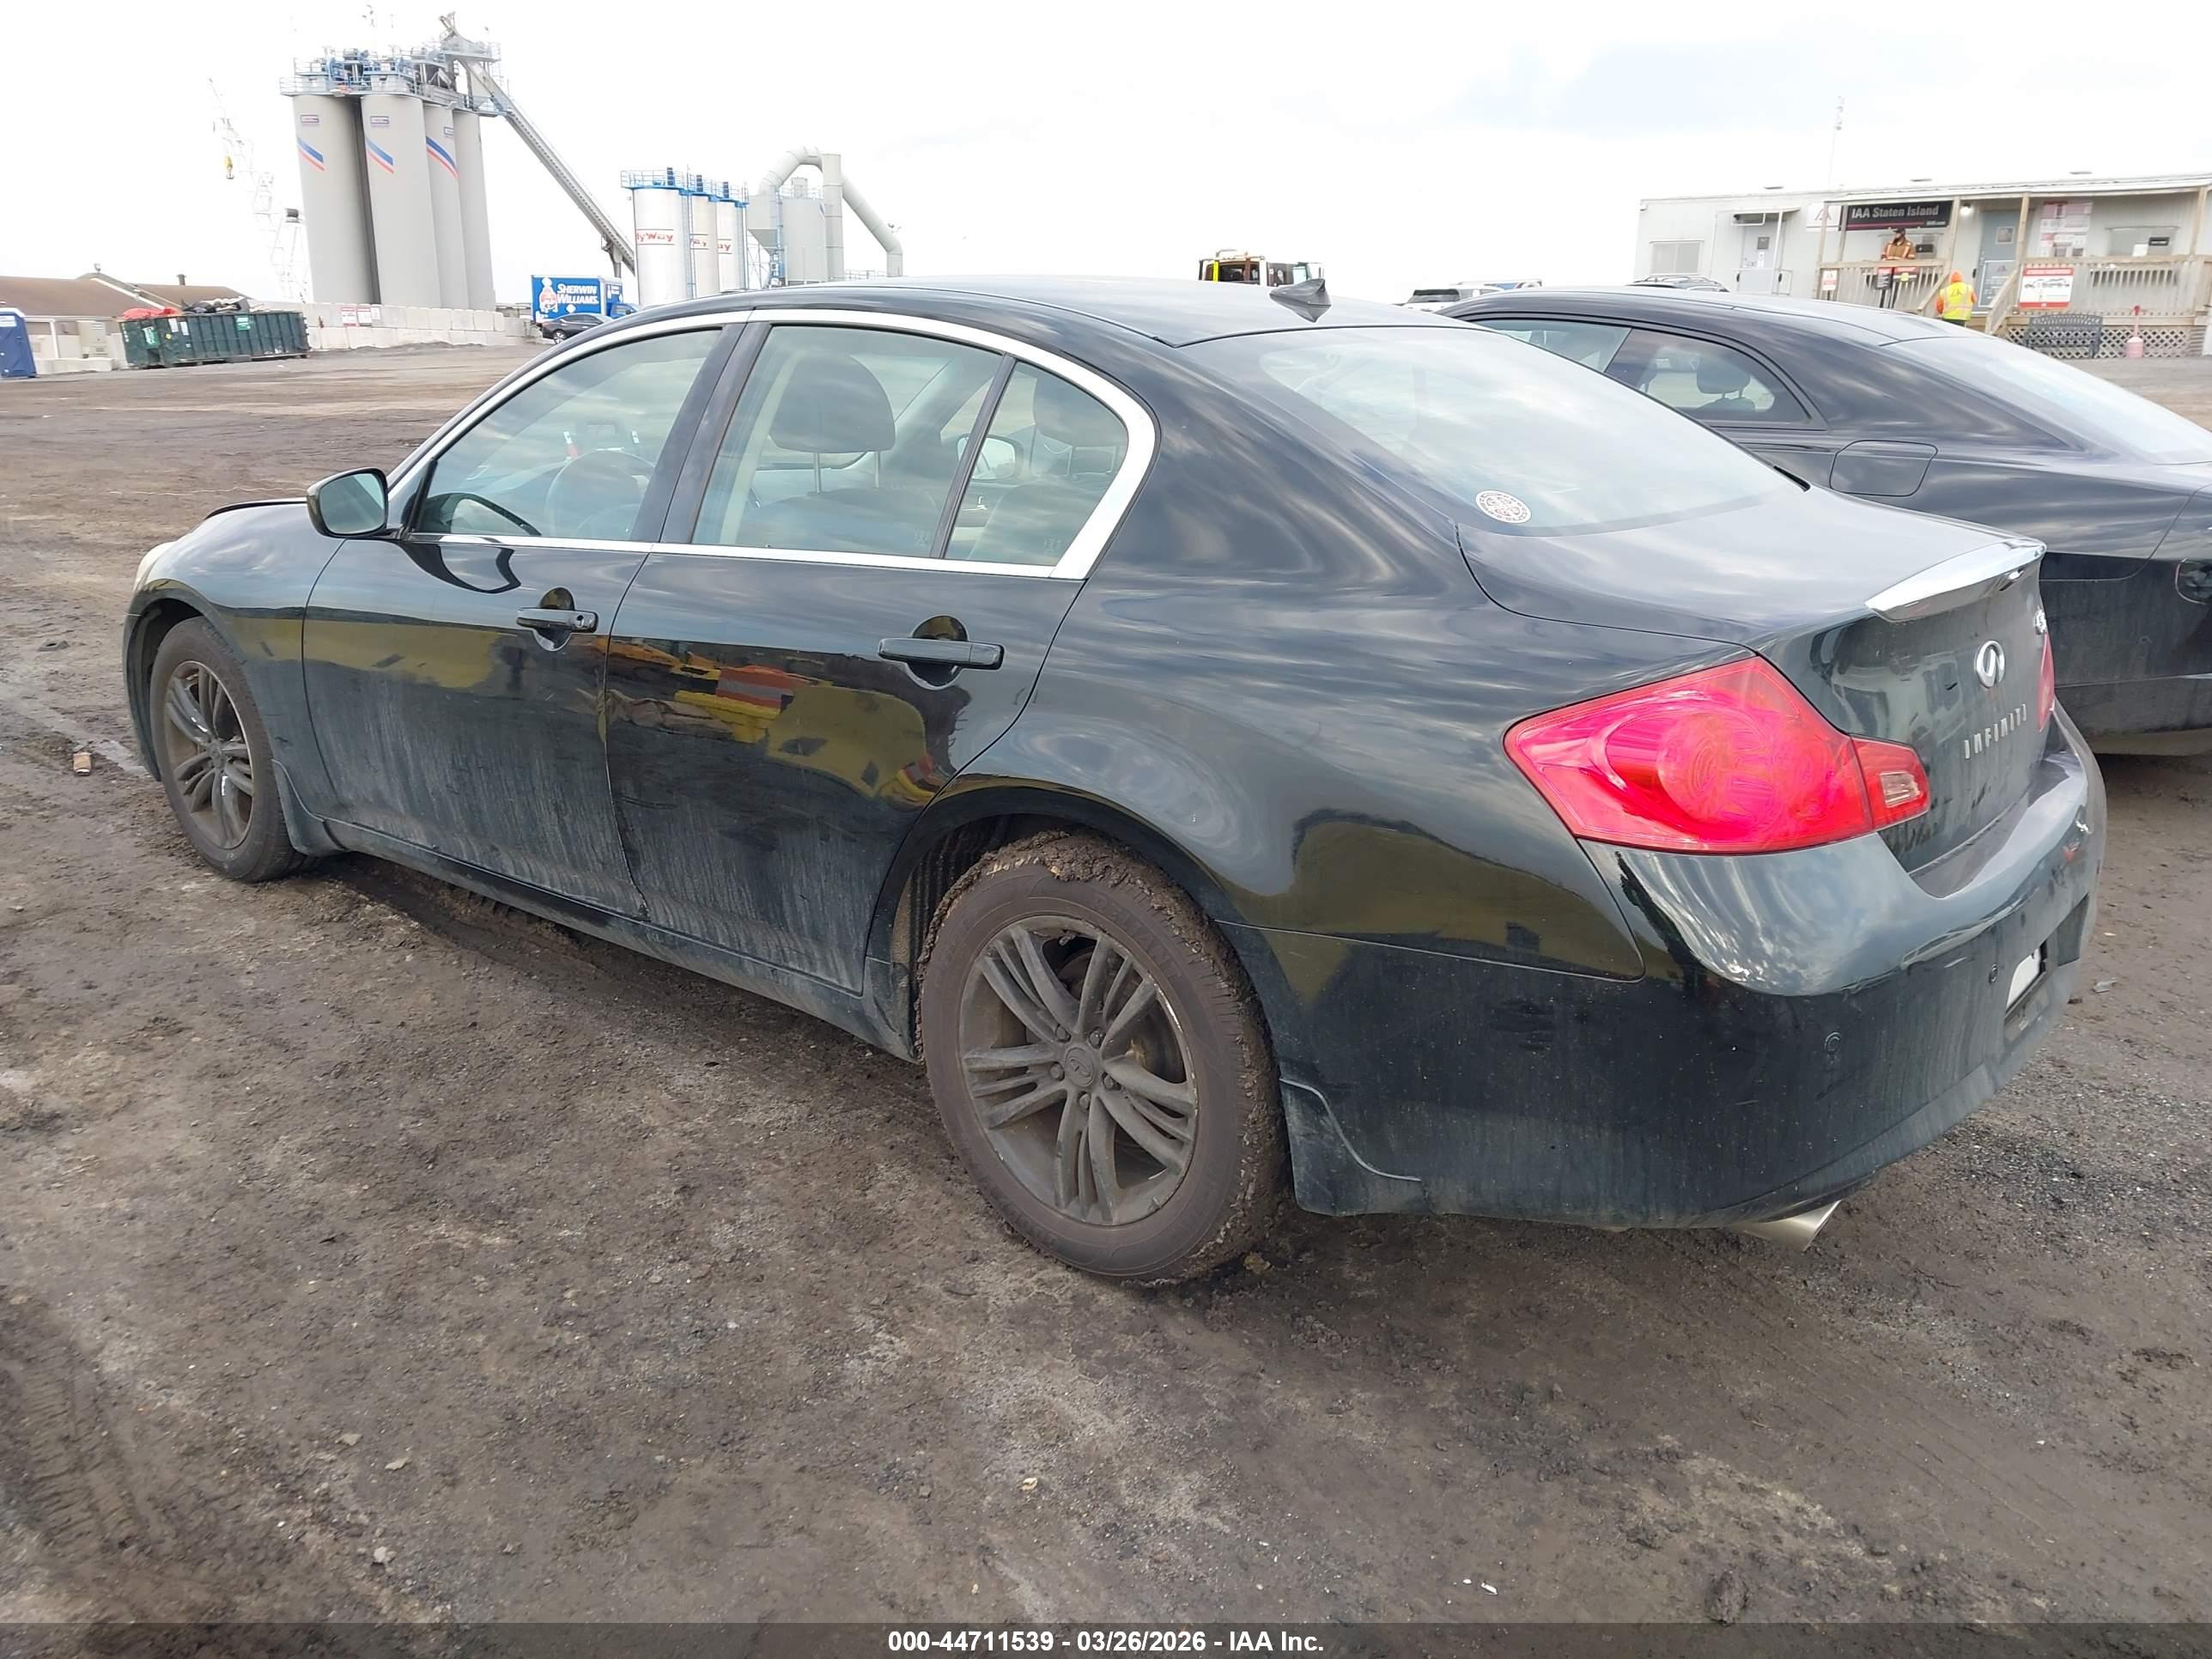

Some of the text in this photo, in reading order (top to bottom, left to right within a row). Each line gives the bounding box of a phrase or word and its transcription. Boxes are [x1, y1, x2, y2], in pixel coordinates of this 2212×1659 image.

[1851, 204, 1939, 219] IAA Staten Island
[557, 283, 598, 295] SHERWIN
[1964, 703, 2027, 759] INFINITI
